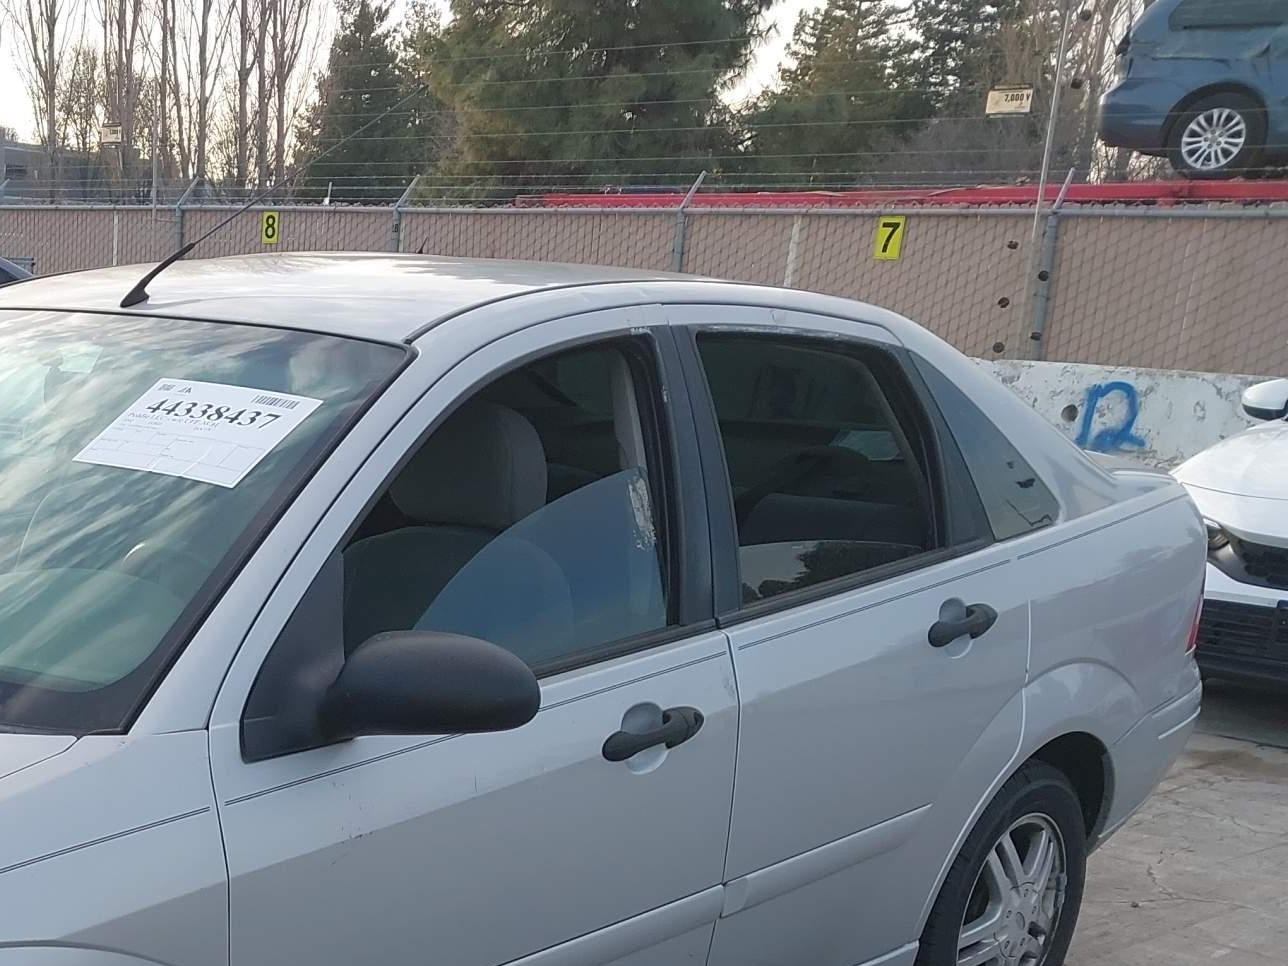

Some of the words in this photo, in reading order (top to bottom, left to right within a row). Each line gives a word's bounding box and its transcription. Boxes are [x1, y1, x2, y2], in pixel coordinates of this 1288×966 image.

[265, 214, 276, 239] 8
[881, 222, 901, 253] 7
[145, 398, 282, 430] 44338437
